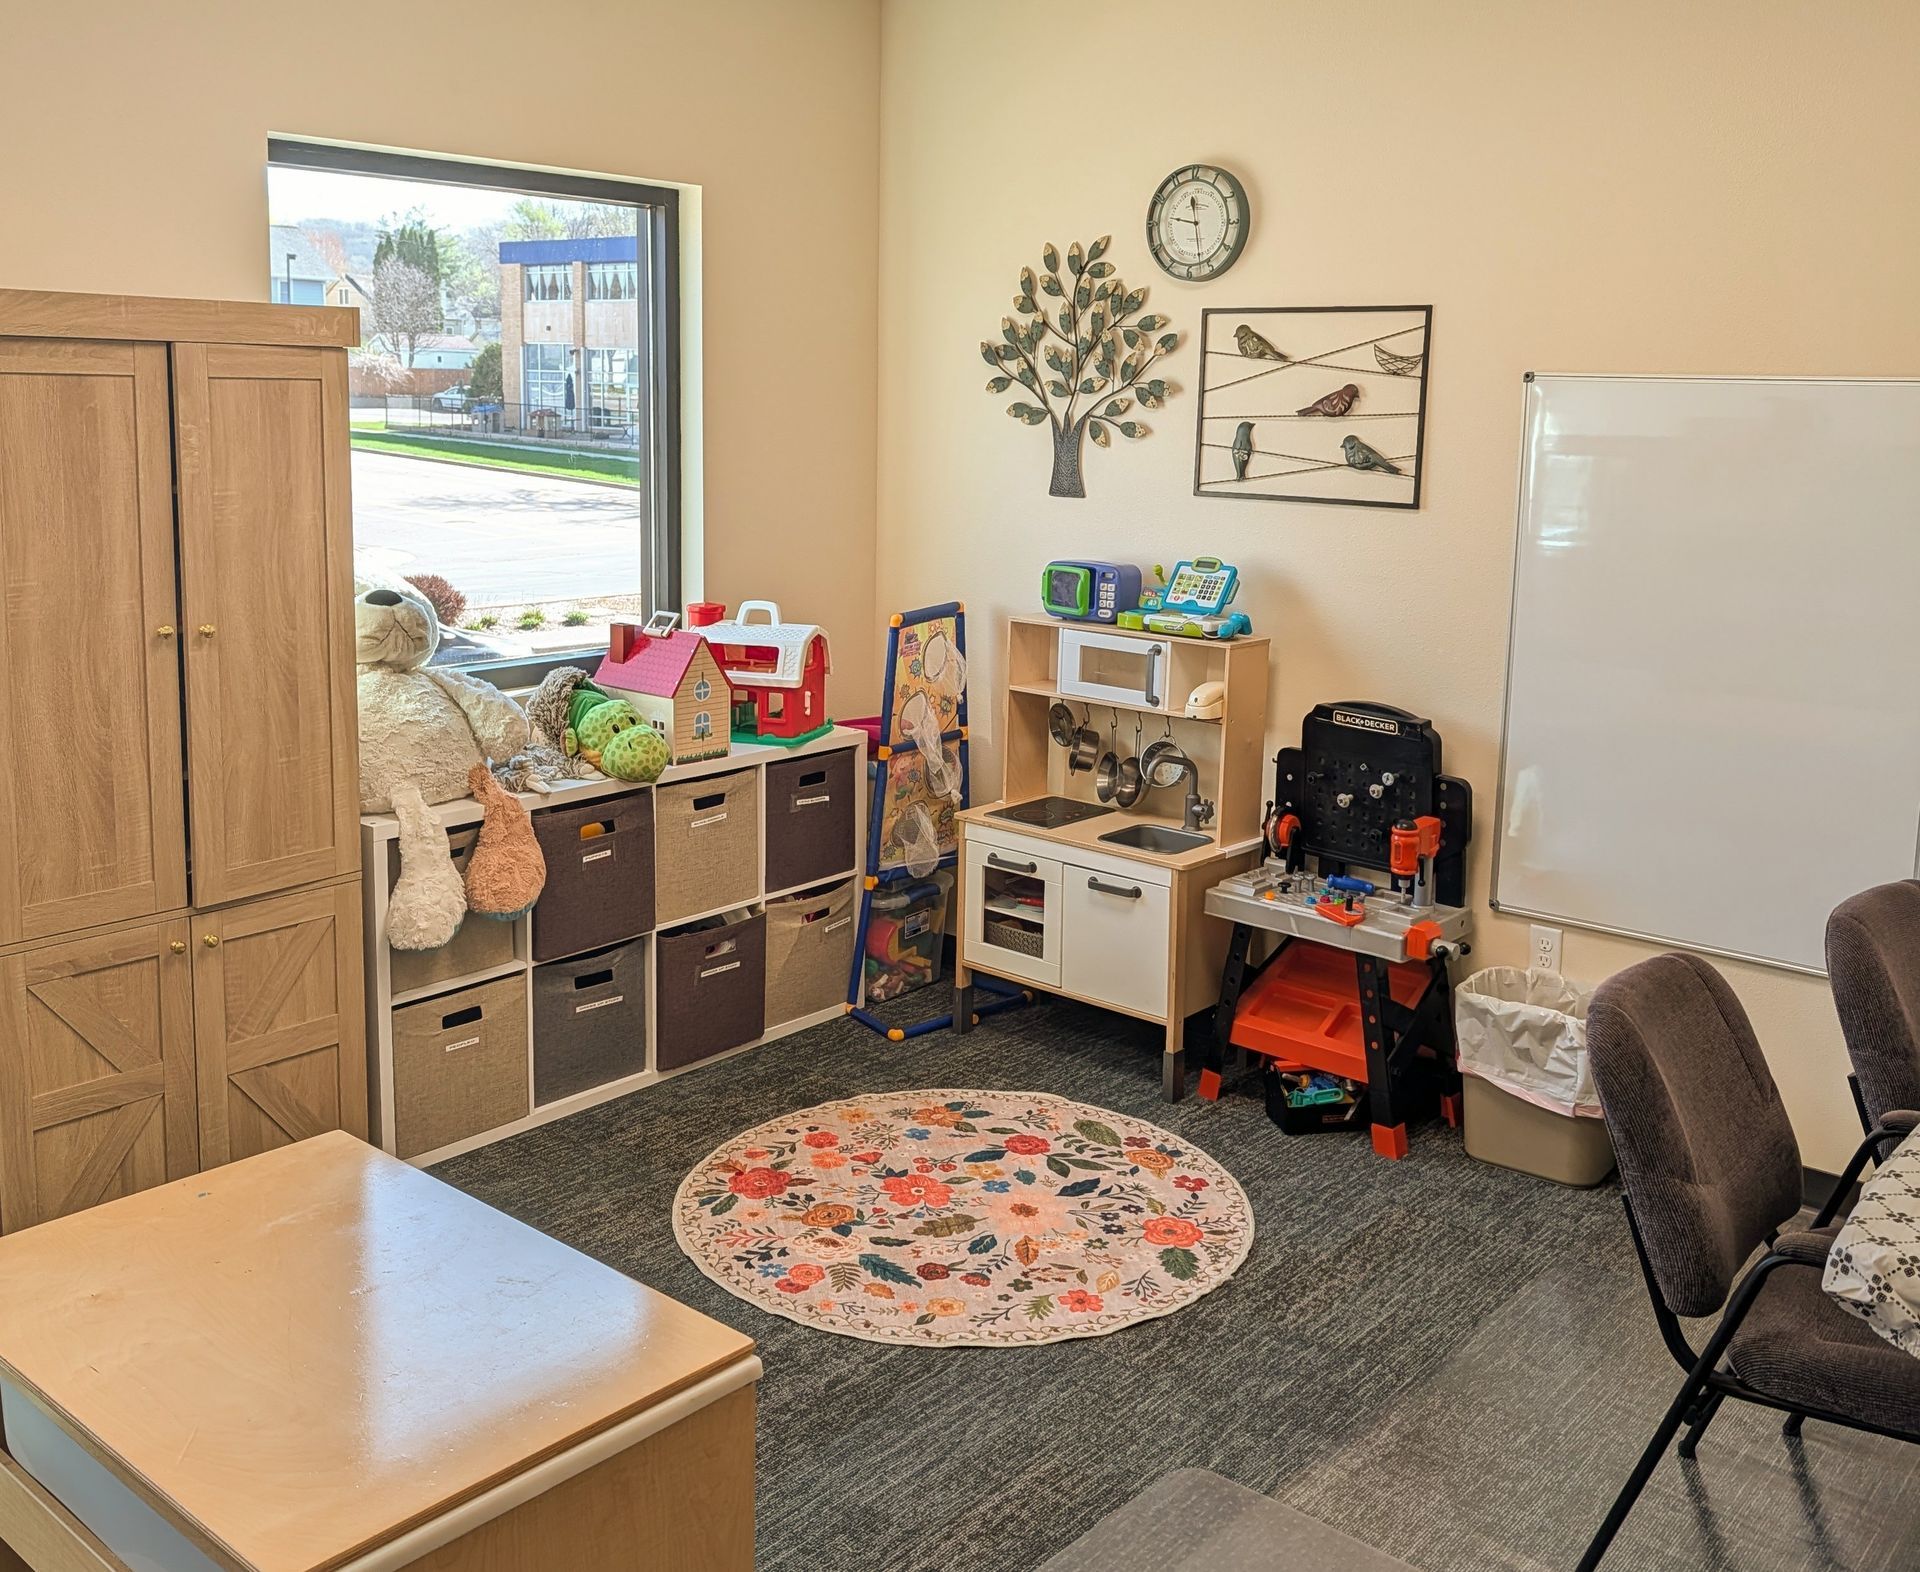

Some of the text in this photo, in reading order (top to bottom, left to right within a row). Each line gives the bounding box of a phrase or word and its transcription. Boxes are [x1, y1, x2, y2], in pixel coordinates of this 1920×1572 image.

[1192, 166, 1200, 180] 12
[1212, 172, 1220, 185] 1
[1171, 173, 1180, 187] 11
[1154, 193, 1166, 205] 10
[1224, 191, 1234, 202] 2
[1147, 220, 1158, 228] 9
[1151, 243, 1162, 253] 8
[1223, 242, 1233, 252] 4
[1166, 259, 1175, 271] 7
[1206, 259, 1215, 272] 5
[1186, 266, 1193, 279] 6
